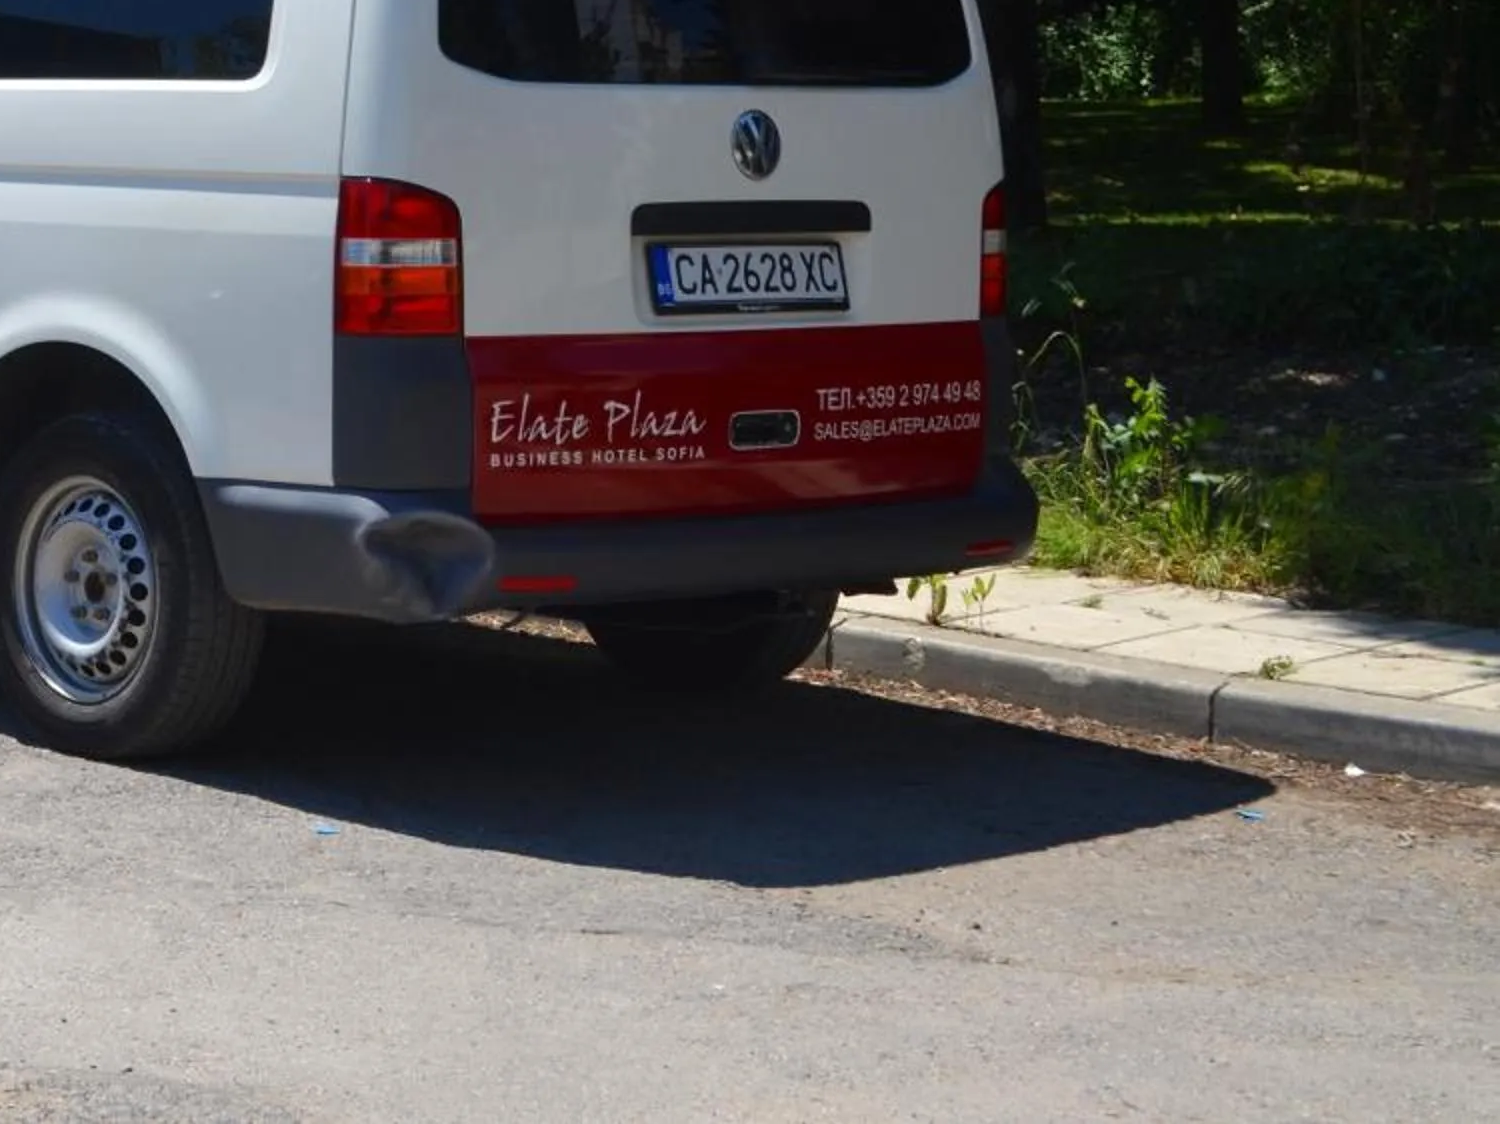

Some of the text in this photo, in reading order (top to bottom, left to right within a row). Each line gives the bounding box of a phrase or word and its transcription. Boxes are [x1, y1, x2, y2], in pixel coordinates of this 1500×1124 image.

[899, 384, 909, 407] 2
[912, 383, 939, 406] 974
[942, 381, 961, 403] 49
[963, 379, 981, 402] 48
[490, 389, 707, 445] Elate Plaza
[813, 412, 981, 442] SALES@ELATEPLAZA.COM
[490, 446, 705, 467] BUSINESS HOTEL SOFIA
